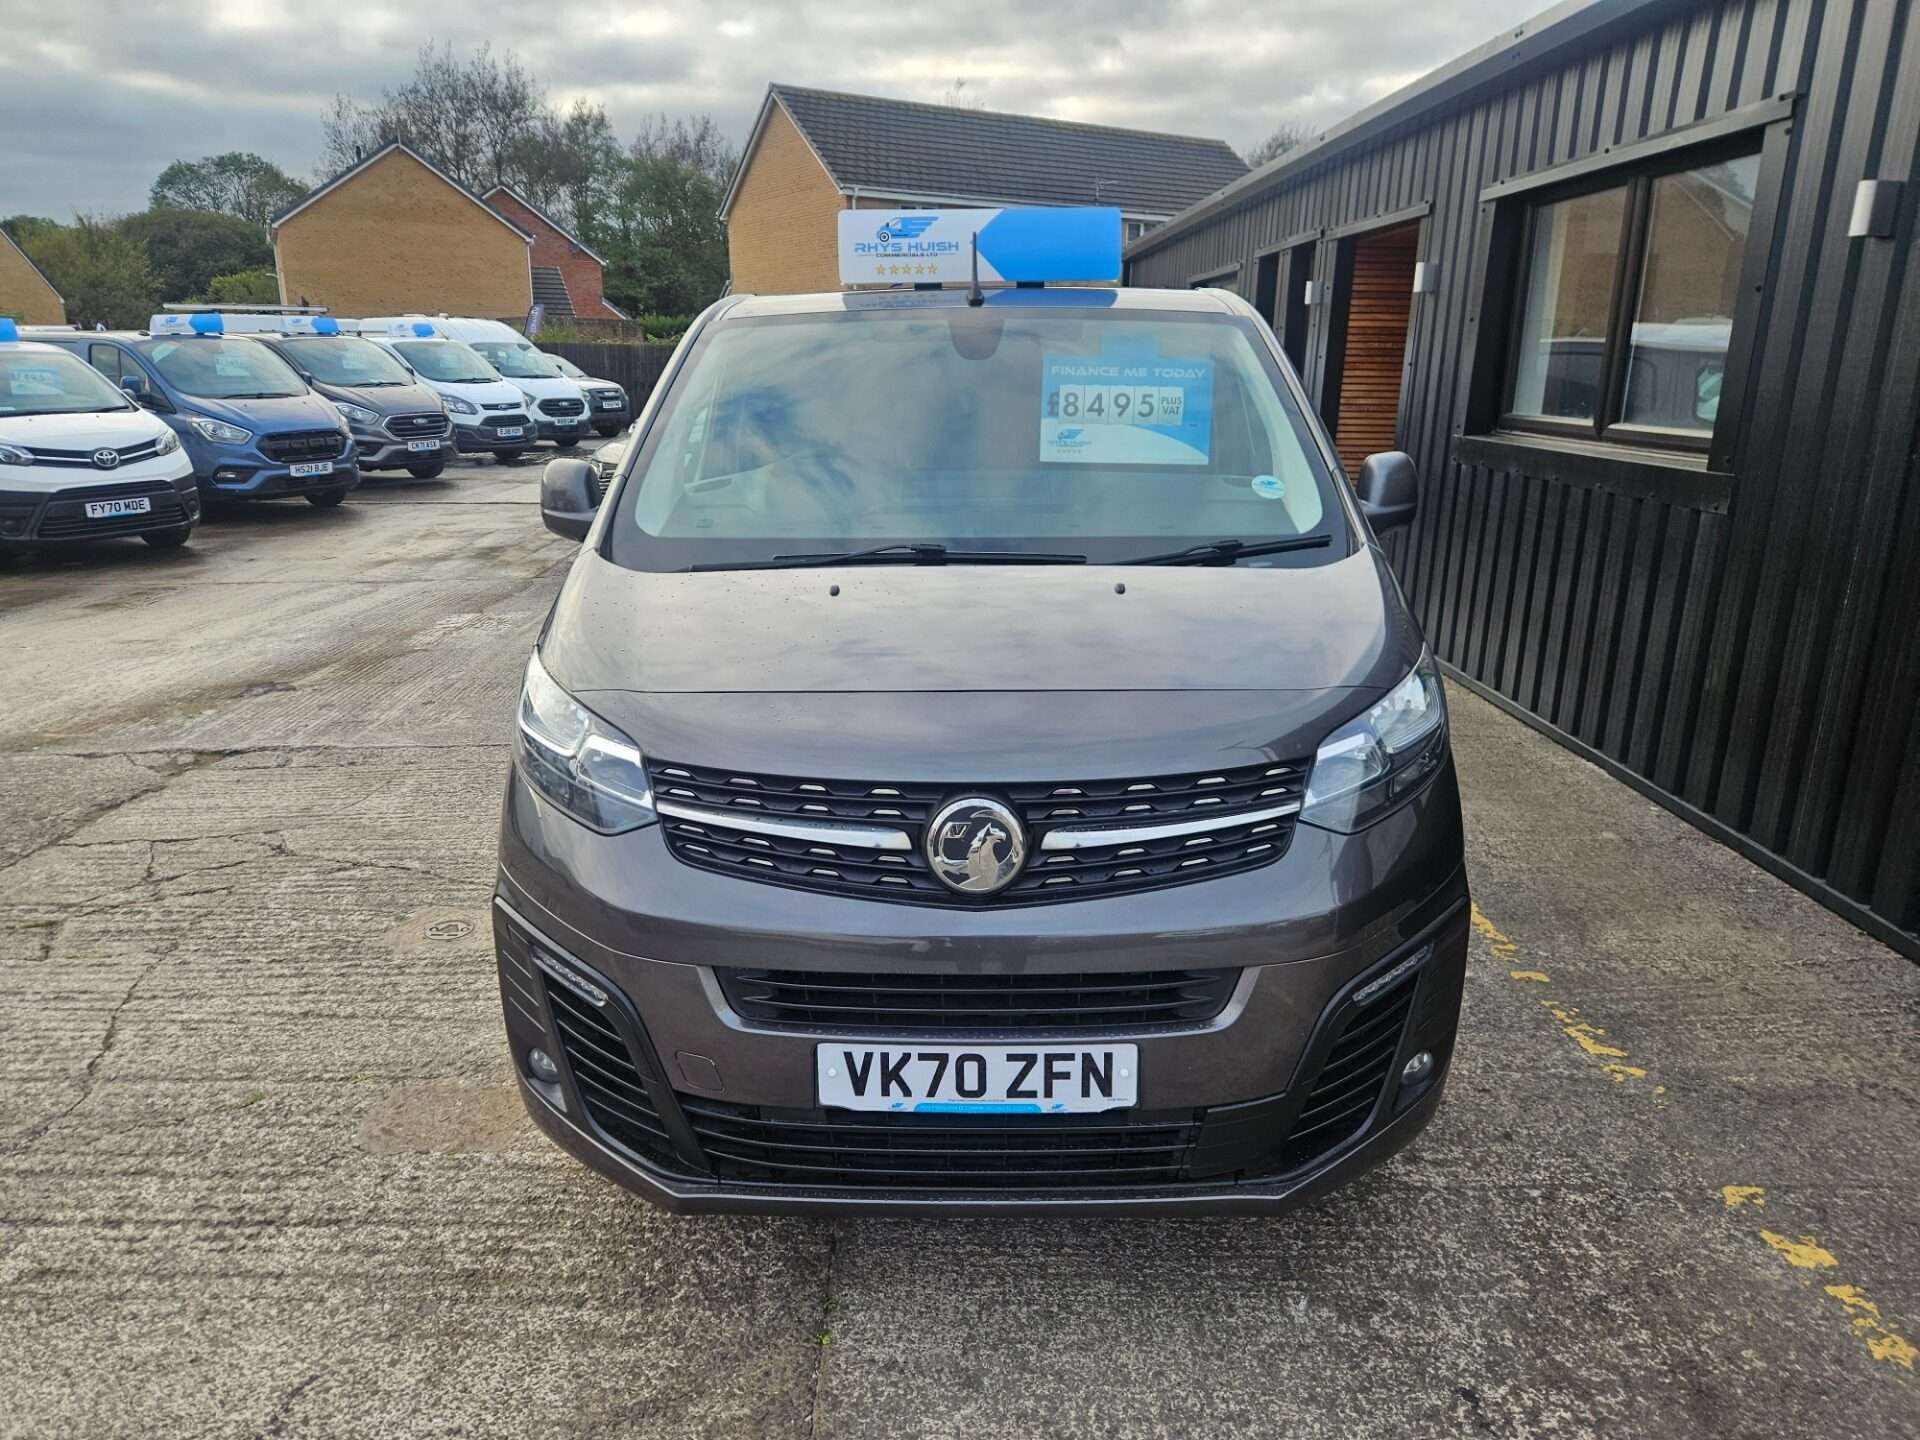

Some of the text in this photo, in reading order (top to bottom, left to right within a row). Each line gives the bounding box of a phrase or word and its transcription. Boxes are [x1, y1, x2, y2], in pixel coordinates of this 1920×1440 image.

[854, 241, 959, 253] RHYS HUISH
[1051, 366, 1206, 378] FINANCE ME TODAY
[1160, 397, 1183, 406] PLUS
[1162, 406, 1181, 415] VAT
[90, 502, 122, 514] FY70
[844, 1051, 1113, 1098] VK70 ZFN
